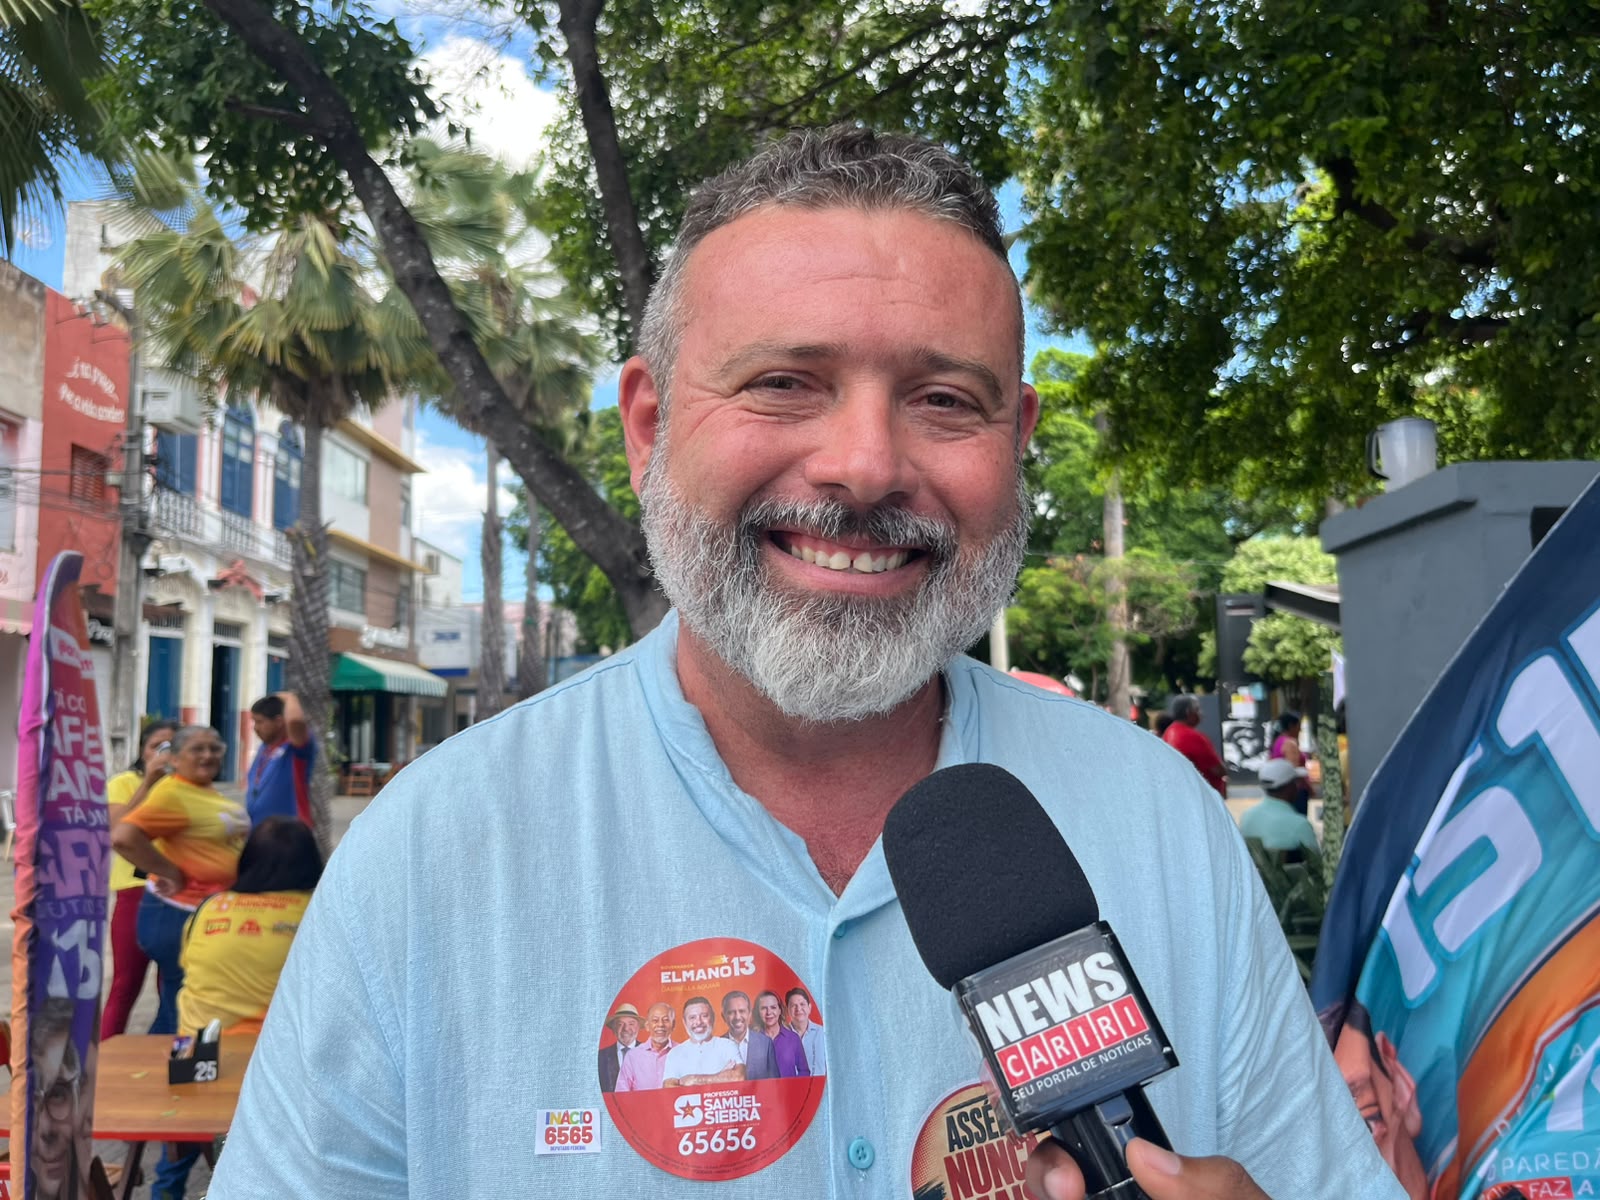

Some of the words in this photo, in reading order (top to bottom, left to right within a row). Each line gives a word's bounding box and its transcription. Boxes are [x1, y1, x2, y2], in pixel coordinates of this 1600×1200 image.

[661, 965, 732, 984] ELMANO
[731, 955, 756, 977] 13
[975, 951, 1127, 1049] NEWS
[1006, 1005, 1137, 1078] CARIRI
[194, 1060, 217, 1081] 25
[1011, 1084, 1035, 1102] SEU
[1036, 1065, 1081, 1092] PORTAL
[1081, 1058, 1097, 1072] DE
[1099, 1033, 1152, 1064] NOTÍCIAS
[703, 1089, 739, 1099] PROFESSOR
[703, 1095, 762, 1111] SAMUEL
[704, 1107, 761, 1125] SIEBRA
[945, 1100, 1005, 1153] ASSÉ
[544, 1125, 593, 1145] 6565
[678, 1126, 756, 1156] 65656
[1529, 1180, 1567, 1198] FAZ
